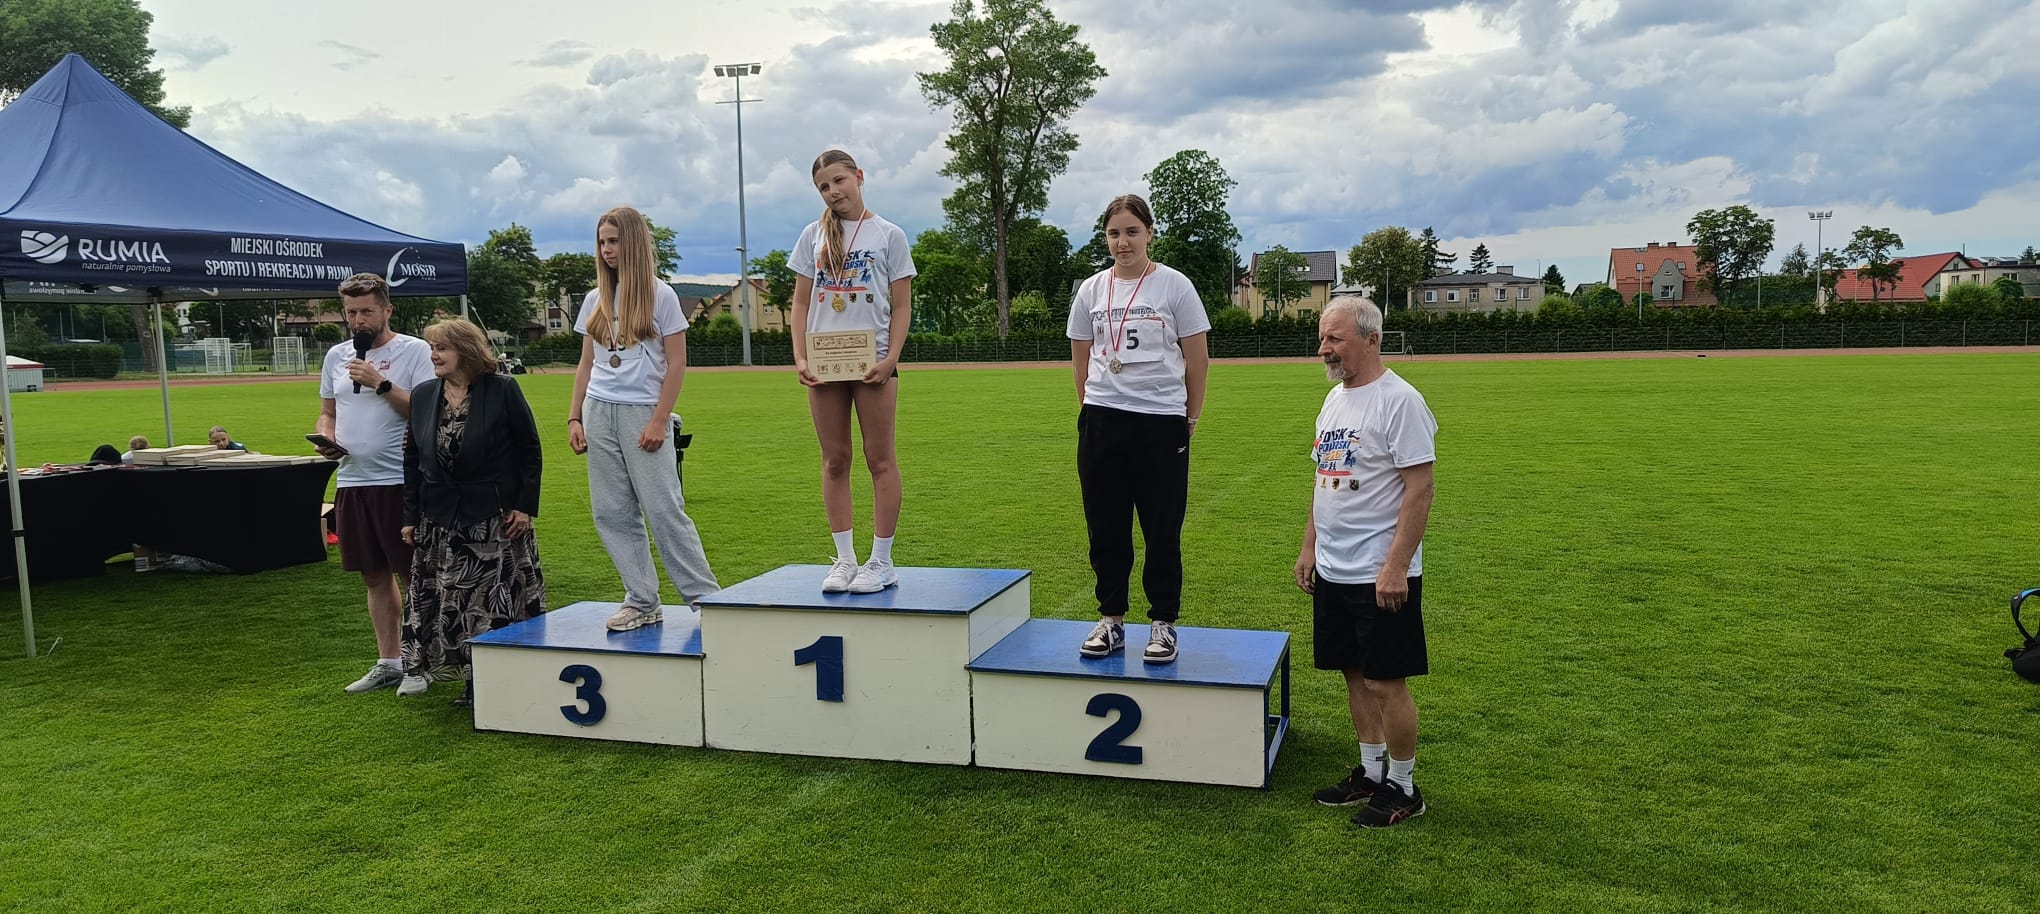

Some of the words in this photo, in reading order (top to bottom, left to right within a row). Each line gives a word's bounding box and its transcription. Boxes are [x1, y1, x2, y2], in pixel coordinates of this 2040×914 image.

[78, 238, 171, 264] RUMIA
[230, 237, 274, 255] MIEJSKI
[276, 238, 323, 258] OŚRODEK
[82, 262, 123, 271] naturalnie
[205, 259, 250, 277] SPORTU
[252, 262, 256, 277] I
[257, 262, 313, 279] REKREACJI
[314, 265, 325, 280] W
[1126, 329, 1139, 350] 5
[794, 635, 845, 702] 1
[559, 664, 606, 726] 3
[1085, 692, 1143, 764] 2
